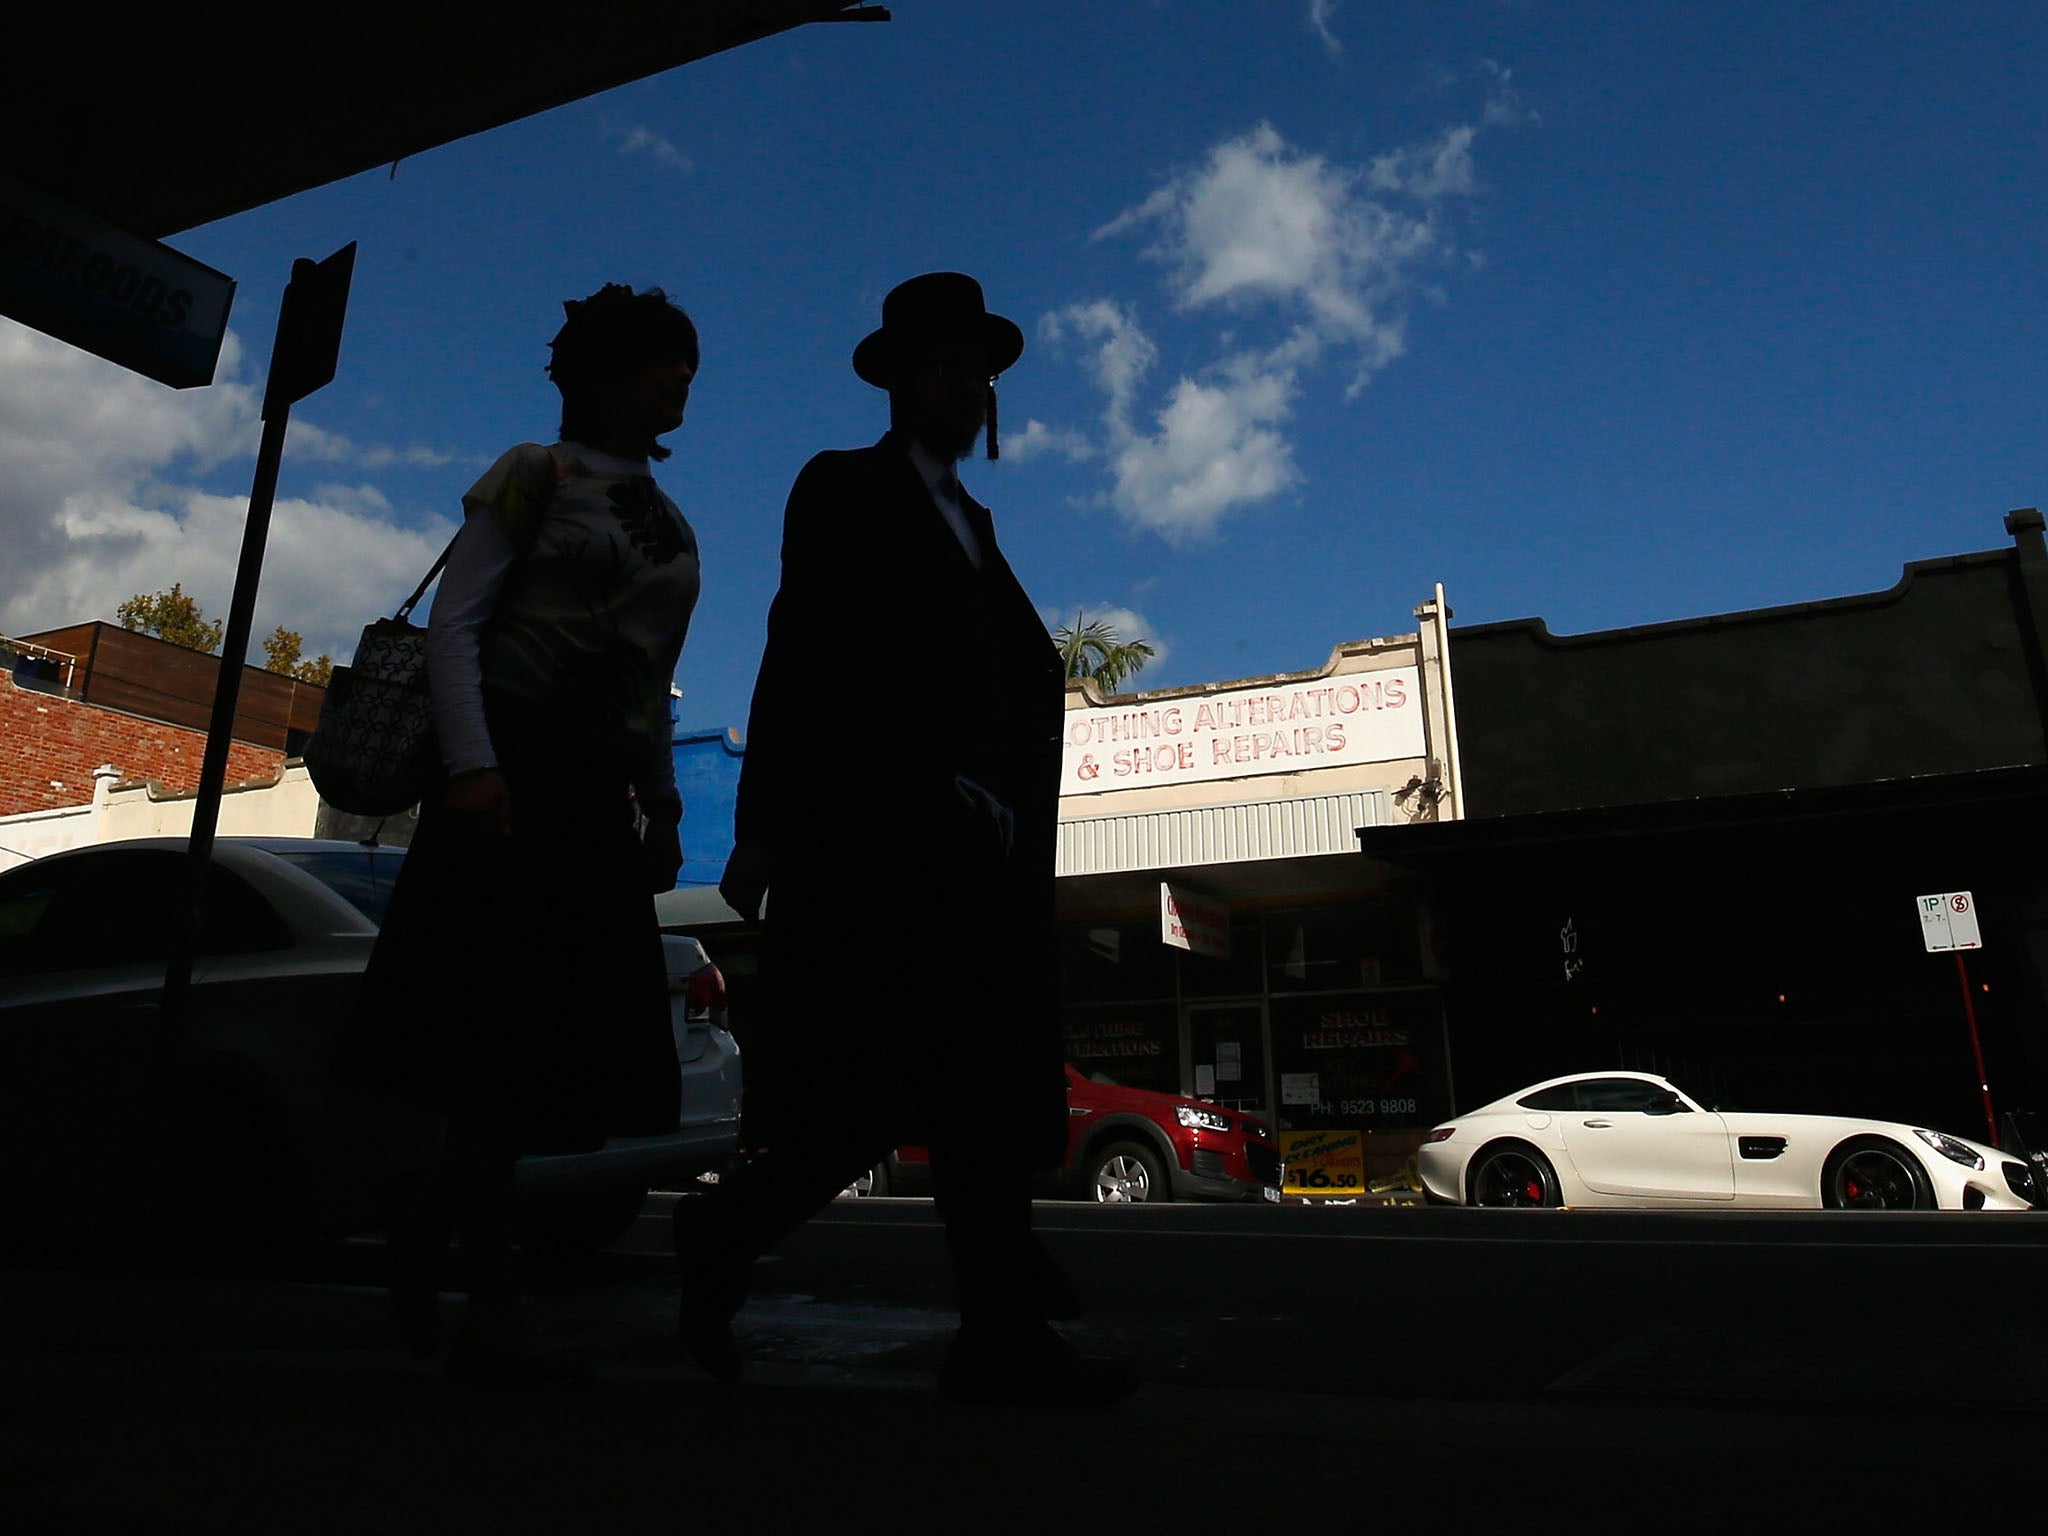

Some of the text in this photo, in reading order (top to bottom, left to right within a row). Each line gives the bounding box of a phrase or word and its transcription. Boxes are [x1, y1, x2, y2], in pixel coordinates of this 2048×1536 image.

[1065, 679, 1406, 747] OTHING ALTERATIONS
[1077, 723, 1346, 781] & SHOE REPAIRS
[1923, 897, 1939, 911] 1P
[1340, 1099, 1375, 1114] 9523
[1380, 1098, 1417, 1114] 9808
[1288, 1169, 1356, 1187] $16.50
